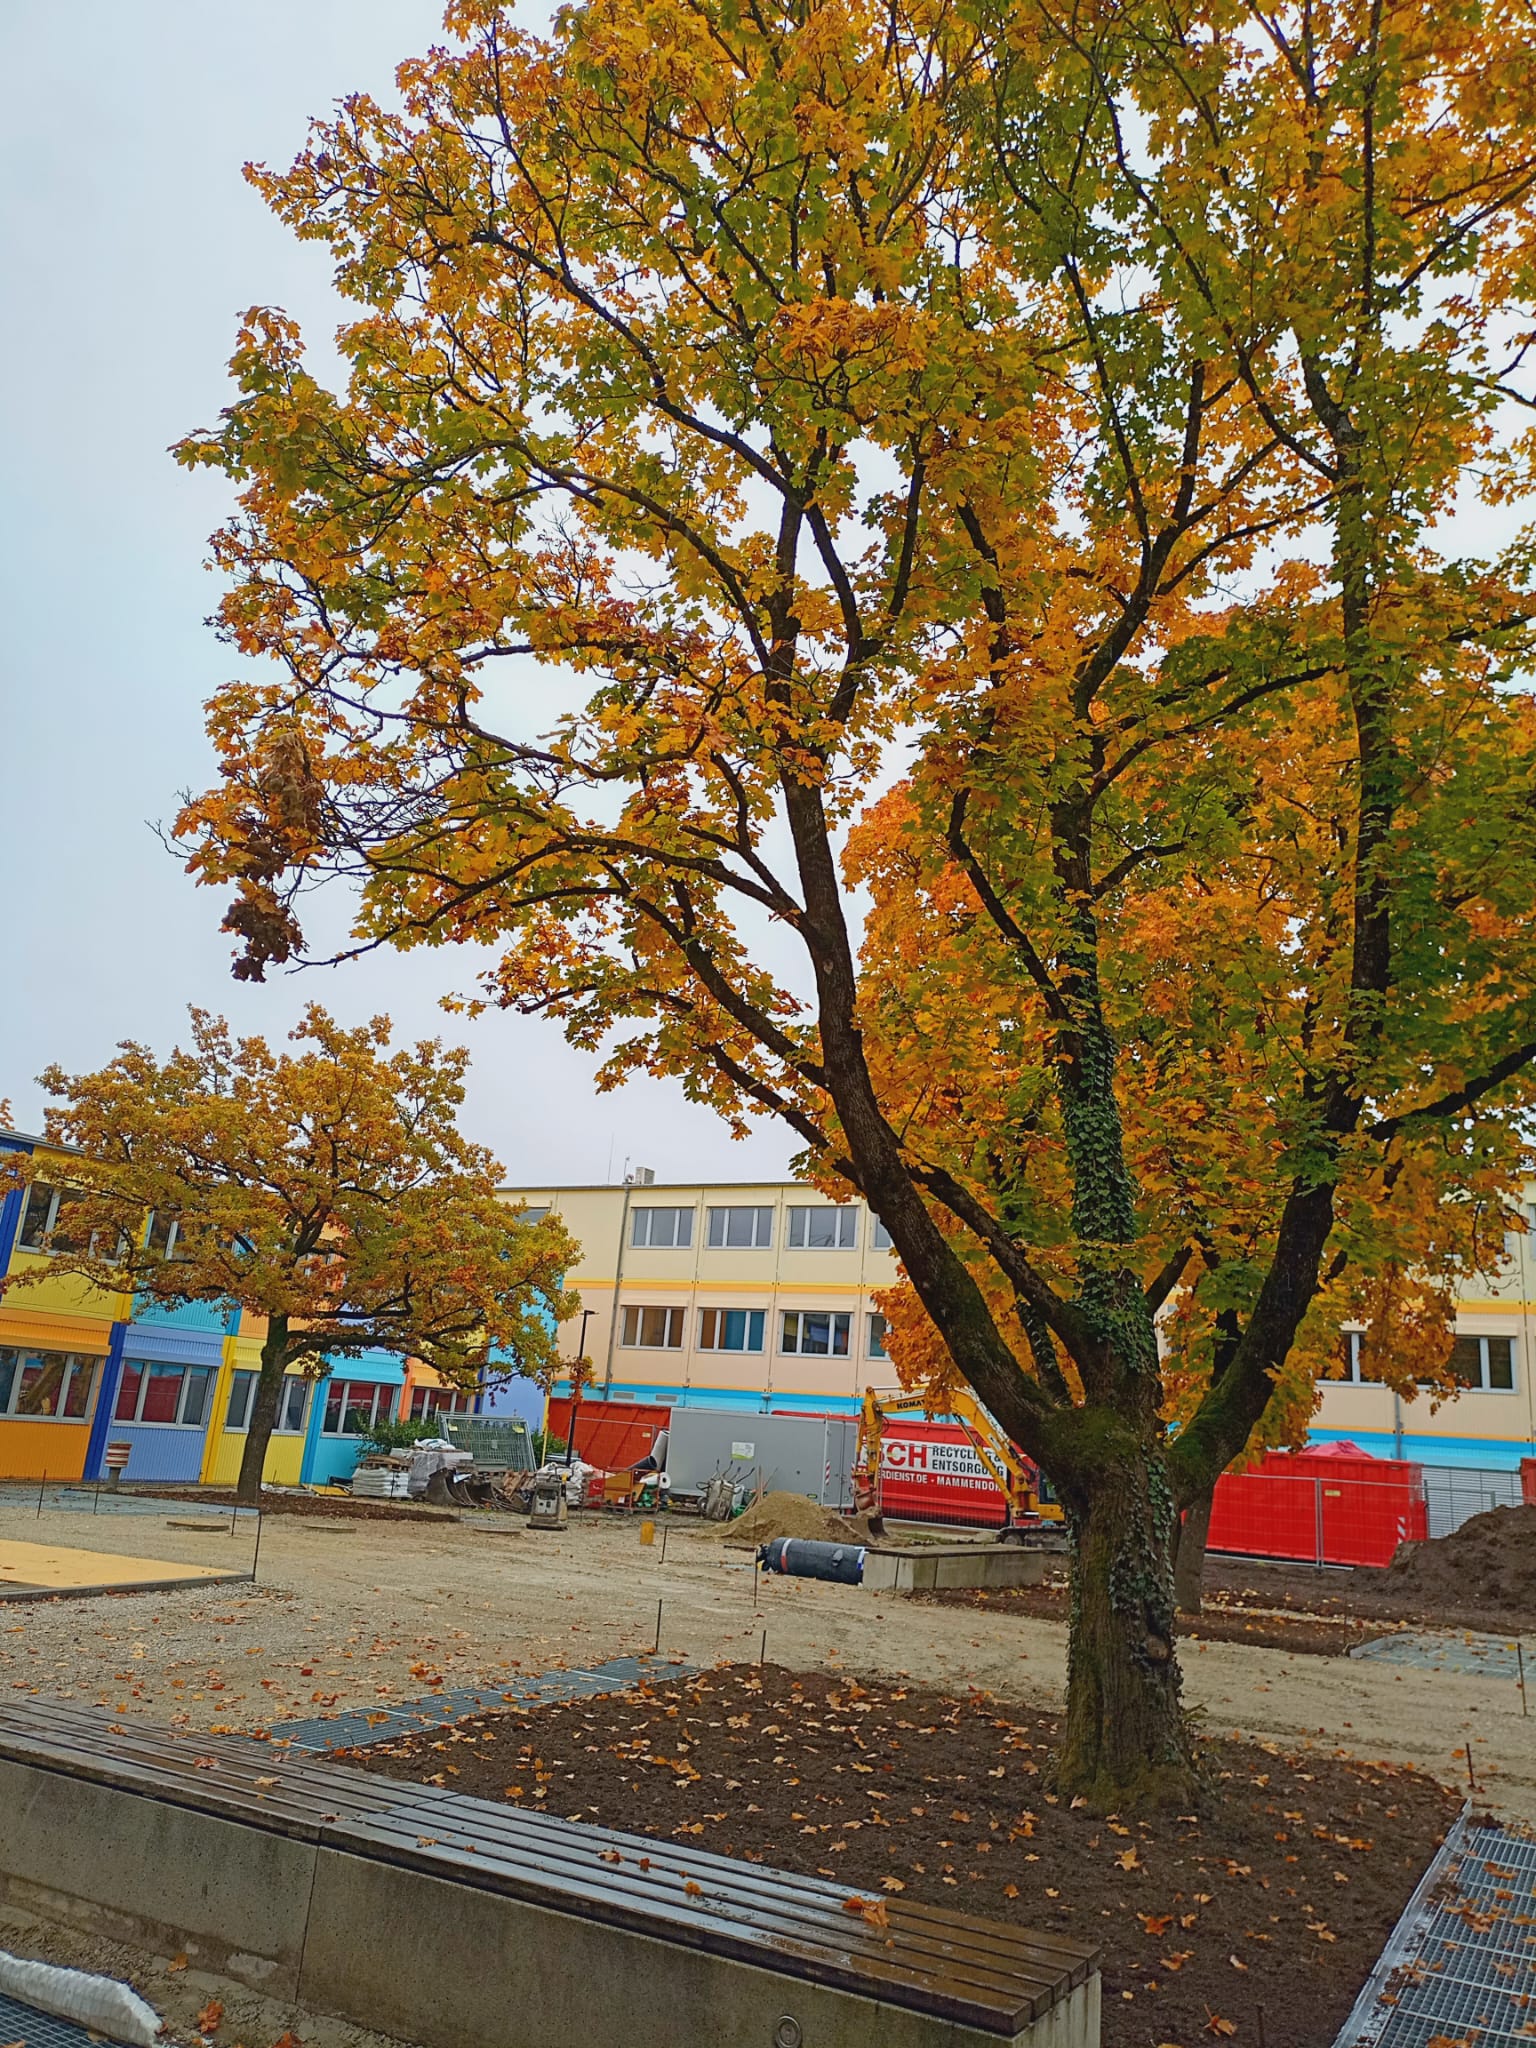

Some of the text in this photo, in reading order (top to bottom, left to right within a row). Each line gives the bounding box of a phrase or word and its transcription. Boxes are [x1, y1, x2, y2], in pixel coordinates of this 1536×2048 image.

[880, 1441, 927, 1468] CH
[932, 1445, 993, 1461] RECYCLIG
[932, 1459, 1004, 1476] ENTSORGUG
